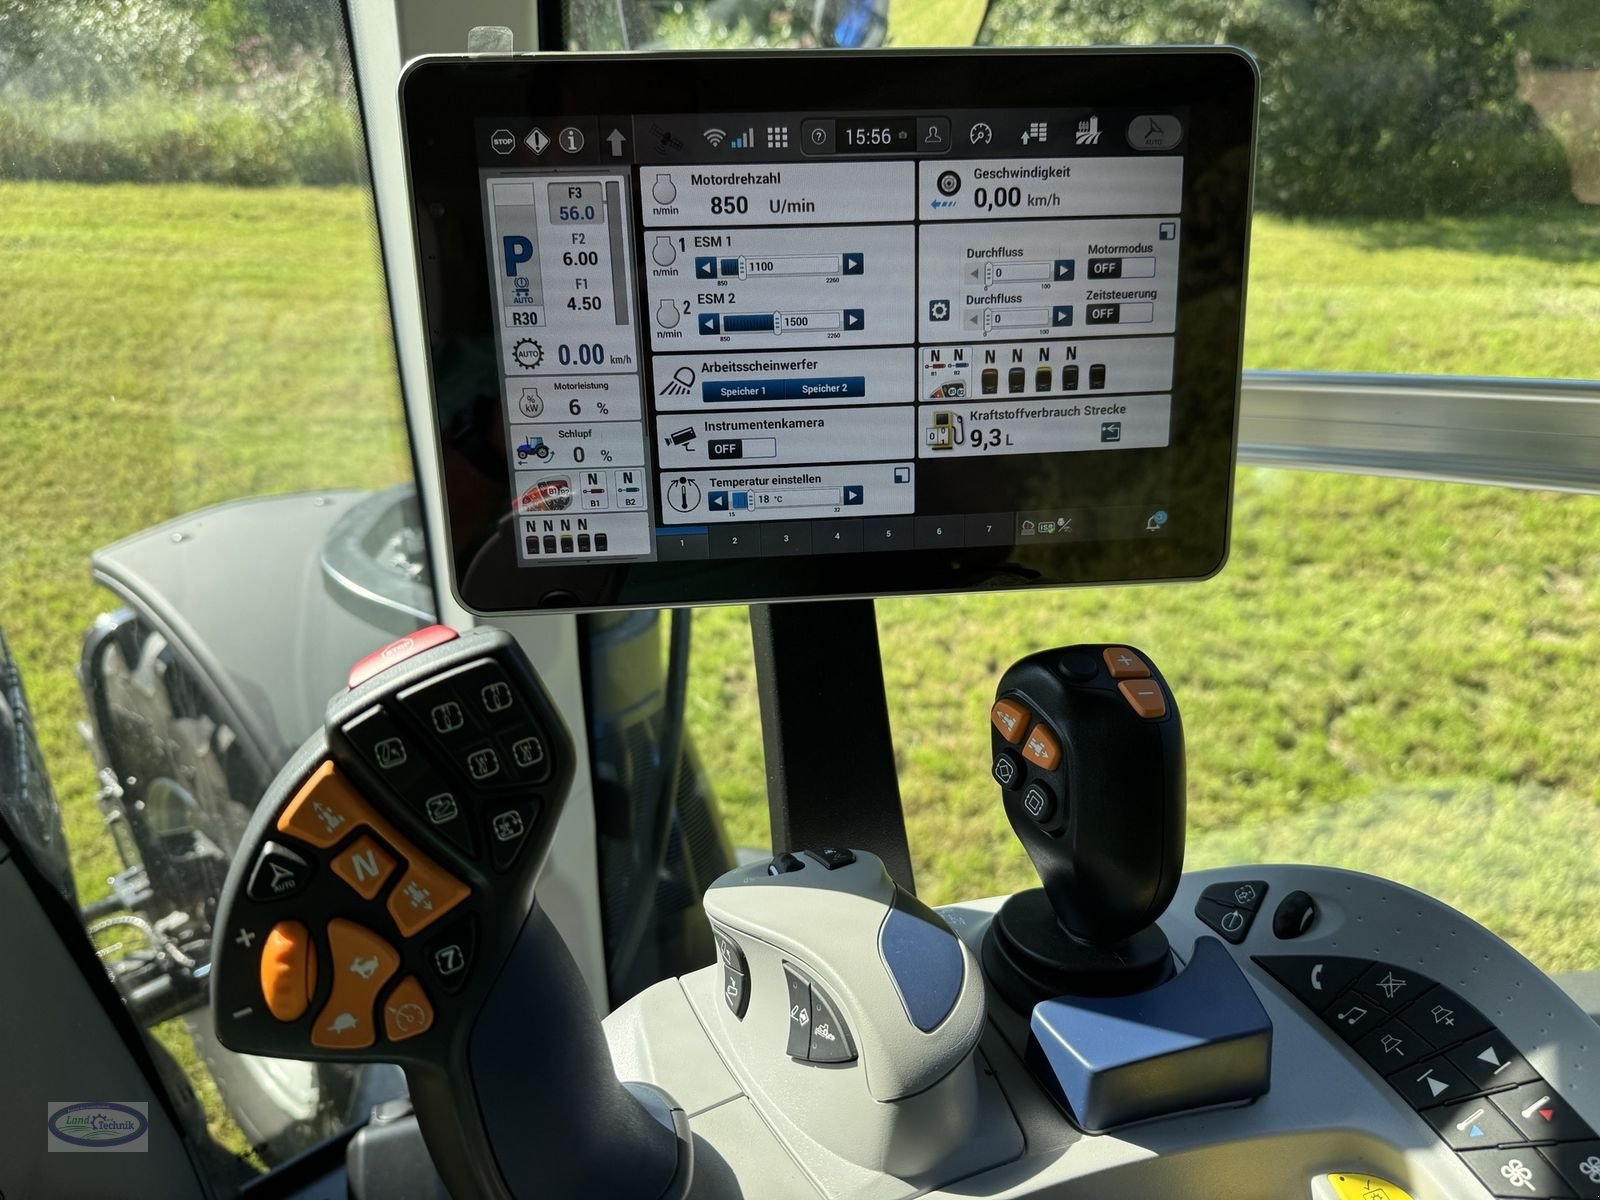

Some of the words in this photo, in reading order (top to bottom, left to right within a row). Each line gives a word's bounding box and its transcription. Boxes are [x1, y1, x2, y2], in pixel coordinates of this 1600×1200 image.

[493, 138, 513, 146] STOP
[845, 127, 892, 146] 15:56
[691, 171, 781, 187] Motordrehzahl
[973, 165, 1071, 181] Geschwindigkeit
[568, 186, 582, 199] F3
[711, 195, 748, 215] 850
[769, 198, 815, 214] U/min
[973, 187, 1022, 212] 0,00
[1027, 193, 1061, 207] km/h
[560, 205, 595, 221] 56.0
[653, 206, 679, 215] n/min
[572, 233, 586, 245] F2
[678, 237, 686, 252] 1
[694, 236, 722, 248] ESM
[726, 236, 732, 247] 1
[967, 246, 1024, 258] Durchfluss
[1087, 242, 1153, 255] Motormodus
[502, 235, 534, 277] P
[563, 251, 598, 266] 6.00
[653, 267, 679, 277] n/min
[749, 260, 774, 272] 1100
[1093, 262, 1116, 274] OFF
[995, 268, 1002, 278] 0
[575, 278, 588, 290] F1
[698, 293, 724, 305] ESM
[728, 292, 736, 304] 2
[966, 293, 1023, 305] Durchfluss
[1085, 289, 1158, 301] Zeitsteuerung
[567, 296, 602, 311] 4.50
[683, 300, 691, 315] 2
[512, 311, 538, 326] R30
[994, 314, 1001, 324] 0
[1092, 308, 1115, 319] OFF
[784, 315, 809, 327] 1500
[657, 330, 683, 339] n/min
[518, 350, 539, 358] AUTO
[558, 343, 605, 366] 0.00
[609, 354, 632, 364] km/h
[931, 349, 940, 362] N
[954, 348, 963, 361] N
[984, 350, 996, 364] N
[1012, 348, 1023, 362] N
[1039, 347, 1050, 361] N
[1066, 346, 1077, 360] N
[701, 359, 818, 373] Arbeitsscheinwerfer
[553, 382, 609, 391] Motorleistung
[720, 386, 759, 398] Speicher
[761, 387, 766, 395] 1
[802, 383, 839, 395] Speicher
[840, 383, 848, 393] 2
[569, 399, 581, 416] 6
[596, 402, 609, 415] %
[970, 406, 1081, 422] Kraftstoffverbrauch
[1083, 404, 1127, 416] Strecke
[704, 418, 825, 432] Instrumentenkamera
[558, 428, 593, 439] Schlupf
[970, 428, 1002, 451] 9,3
[1006, 434, 1014, 446] L
[573, 446, 585, 463] 0
[600, 450, 613, 462] %
[714, 444, 736, 454] OFF
[587, 473, 598, 485] N
[623, 471, 633, 484] N
[709, 475, 770, 489] Temperatur
[771, 473, 822, 485] einstellen
[625, 498, 636, 506] B2
[758, 494, 770, 504] 18
[526, 520, 536, 532] N
[543, 519, 553, 531] N
[560, 519, 570, 531] N
[577, 518, 587, 530] N
[936, 527, 942, 535] 6
[986, 525, 992, 533] 7
[783, 534, 790, 542] 3
[834, 531, 840, 540] 4
[886, 529, 892, 538] 5
[679, 539, 685, 547] 1
[732, 537, 738, 545] 2
[351, 849, 380, 882] N
[274, 879, 296, 893] AUTO
[441, 950, 455, 970] 7
